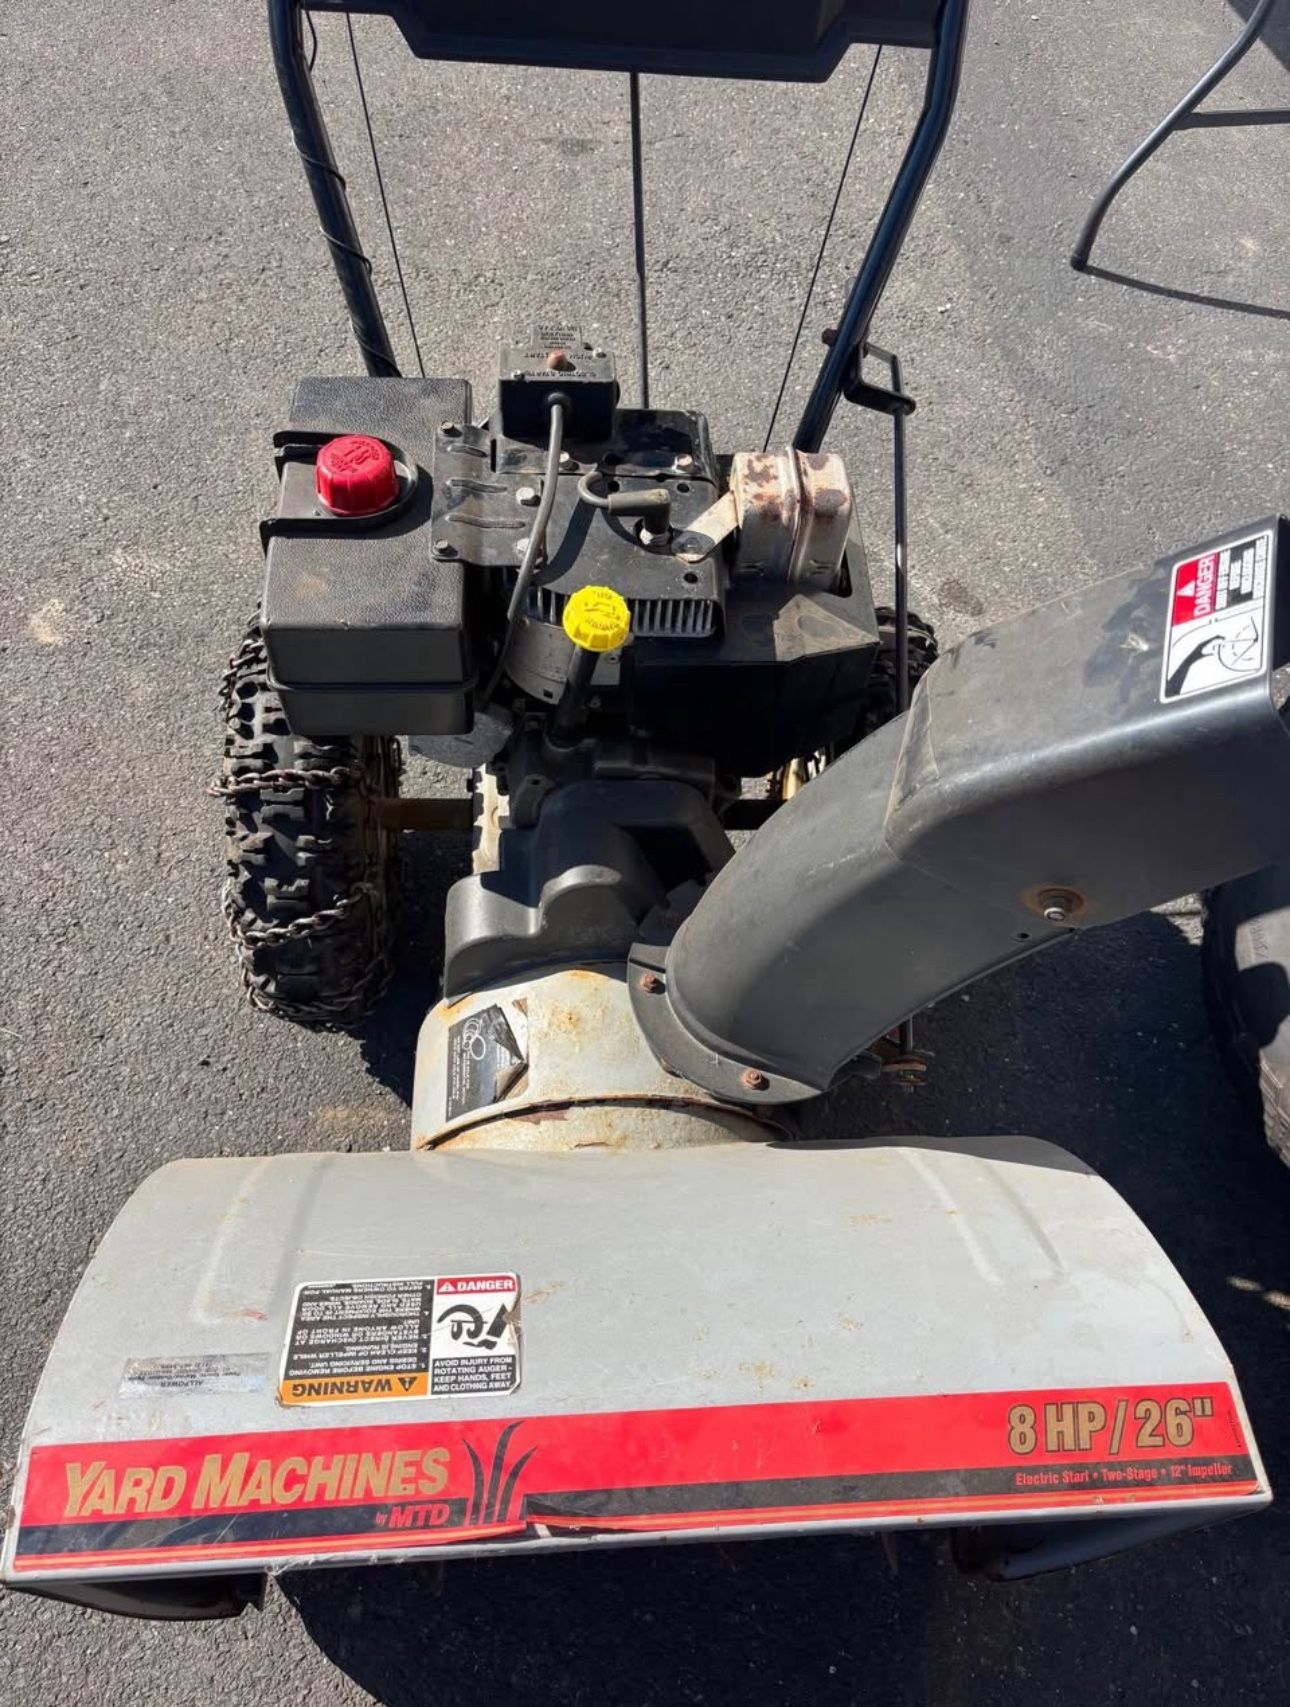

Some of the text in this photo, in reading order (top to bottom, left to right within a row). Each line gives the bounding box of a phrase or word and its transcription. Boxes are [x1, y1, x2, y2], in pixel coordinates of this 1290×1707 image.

[1194, 556, 1215, 616] DANGER
[456, 1280, 514, 1292] DANGER
[434, 1366, 476, 1375] ROTATING
[292, 1378, 392, 1397] WARNING
[450, 1382, 487, 1391] CLOTHING
[1008, 1404, 1036, 1455] 8
[65, 1447, 451, 1518] YARD MACHINES
[1015, 1471, 1059, 1486] Electric
[1062, 1468, 1089, 1483] Start
[1102, 1466, 1157, 1482] Two-Stage
[1170, 1465, 1186, 1478] 12"
[376, 1502, 451, 1528] by MTD
